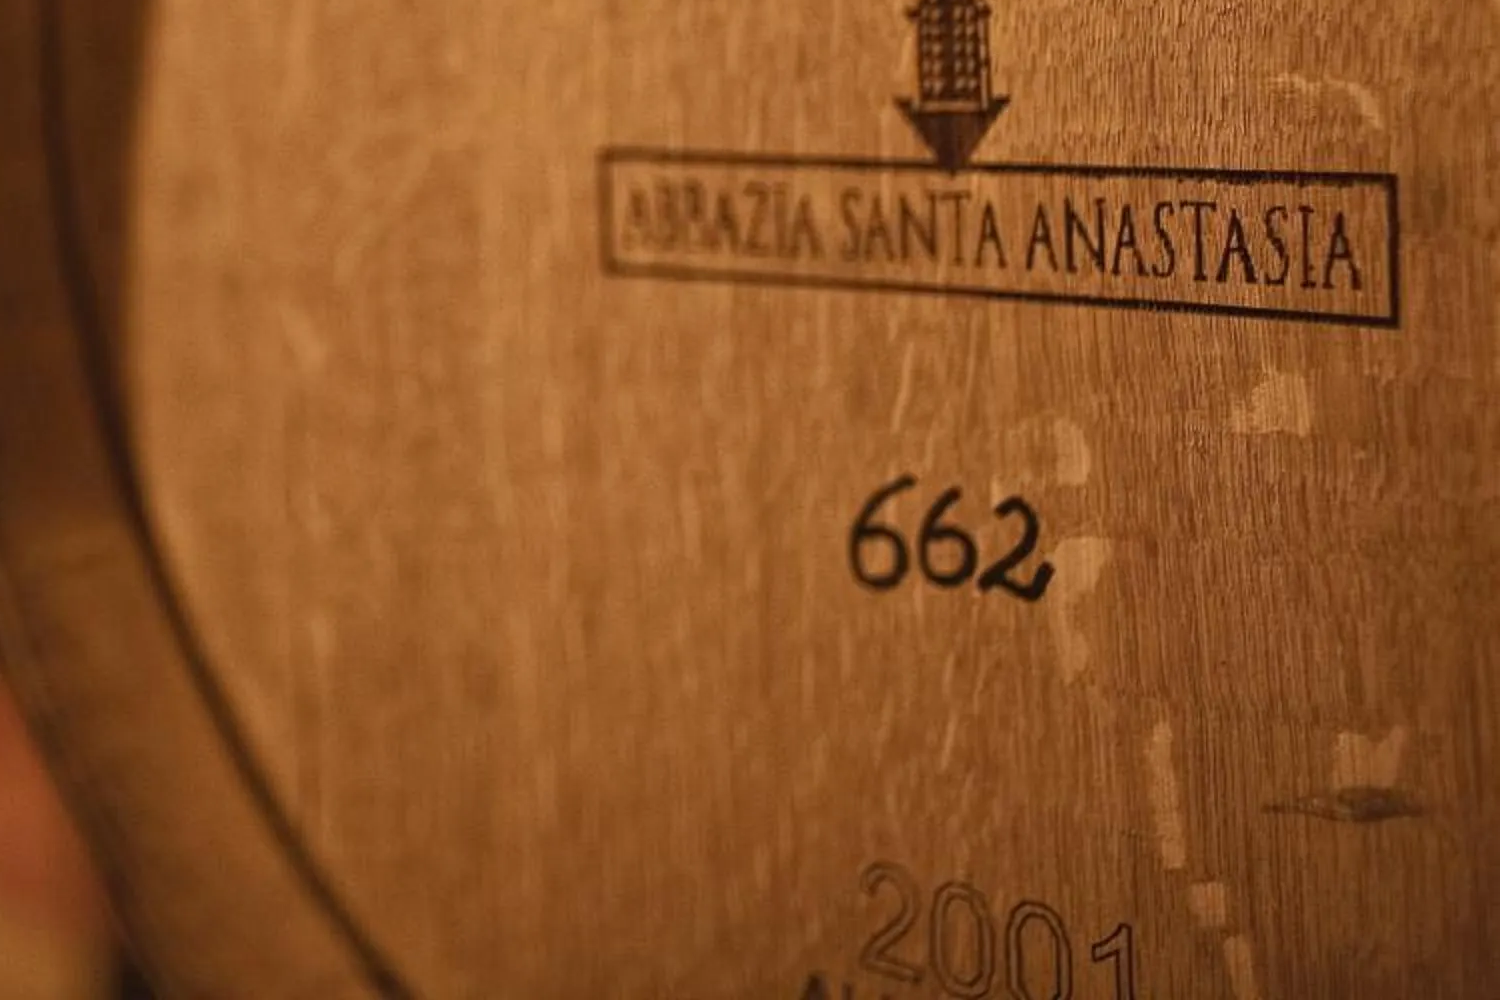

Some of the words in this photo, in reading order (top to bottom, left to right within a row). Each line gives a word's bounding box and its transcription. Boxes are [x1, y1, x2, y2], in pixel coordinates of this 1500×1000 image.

[839, 186, 1008, 272] SANTA
[1025, 196, 1363, 291] ANASTASIA
[848, 474, 1056, 602] 662
[857, 860, 1137, 1000] 2001
